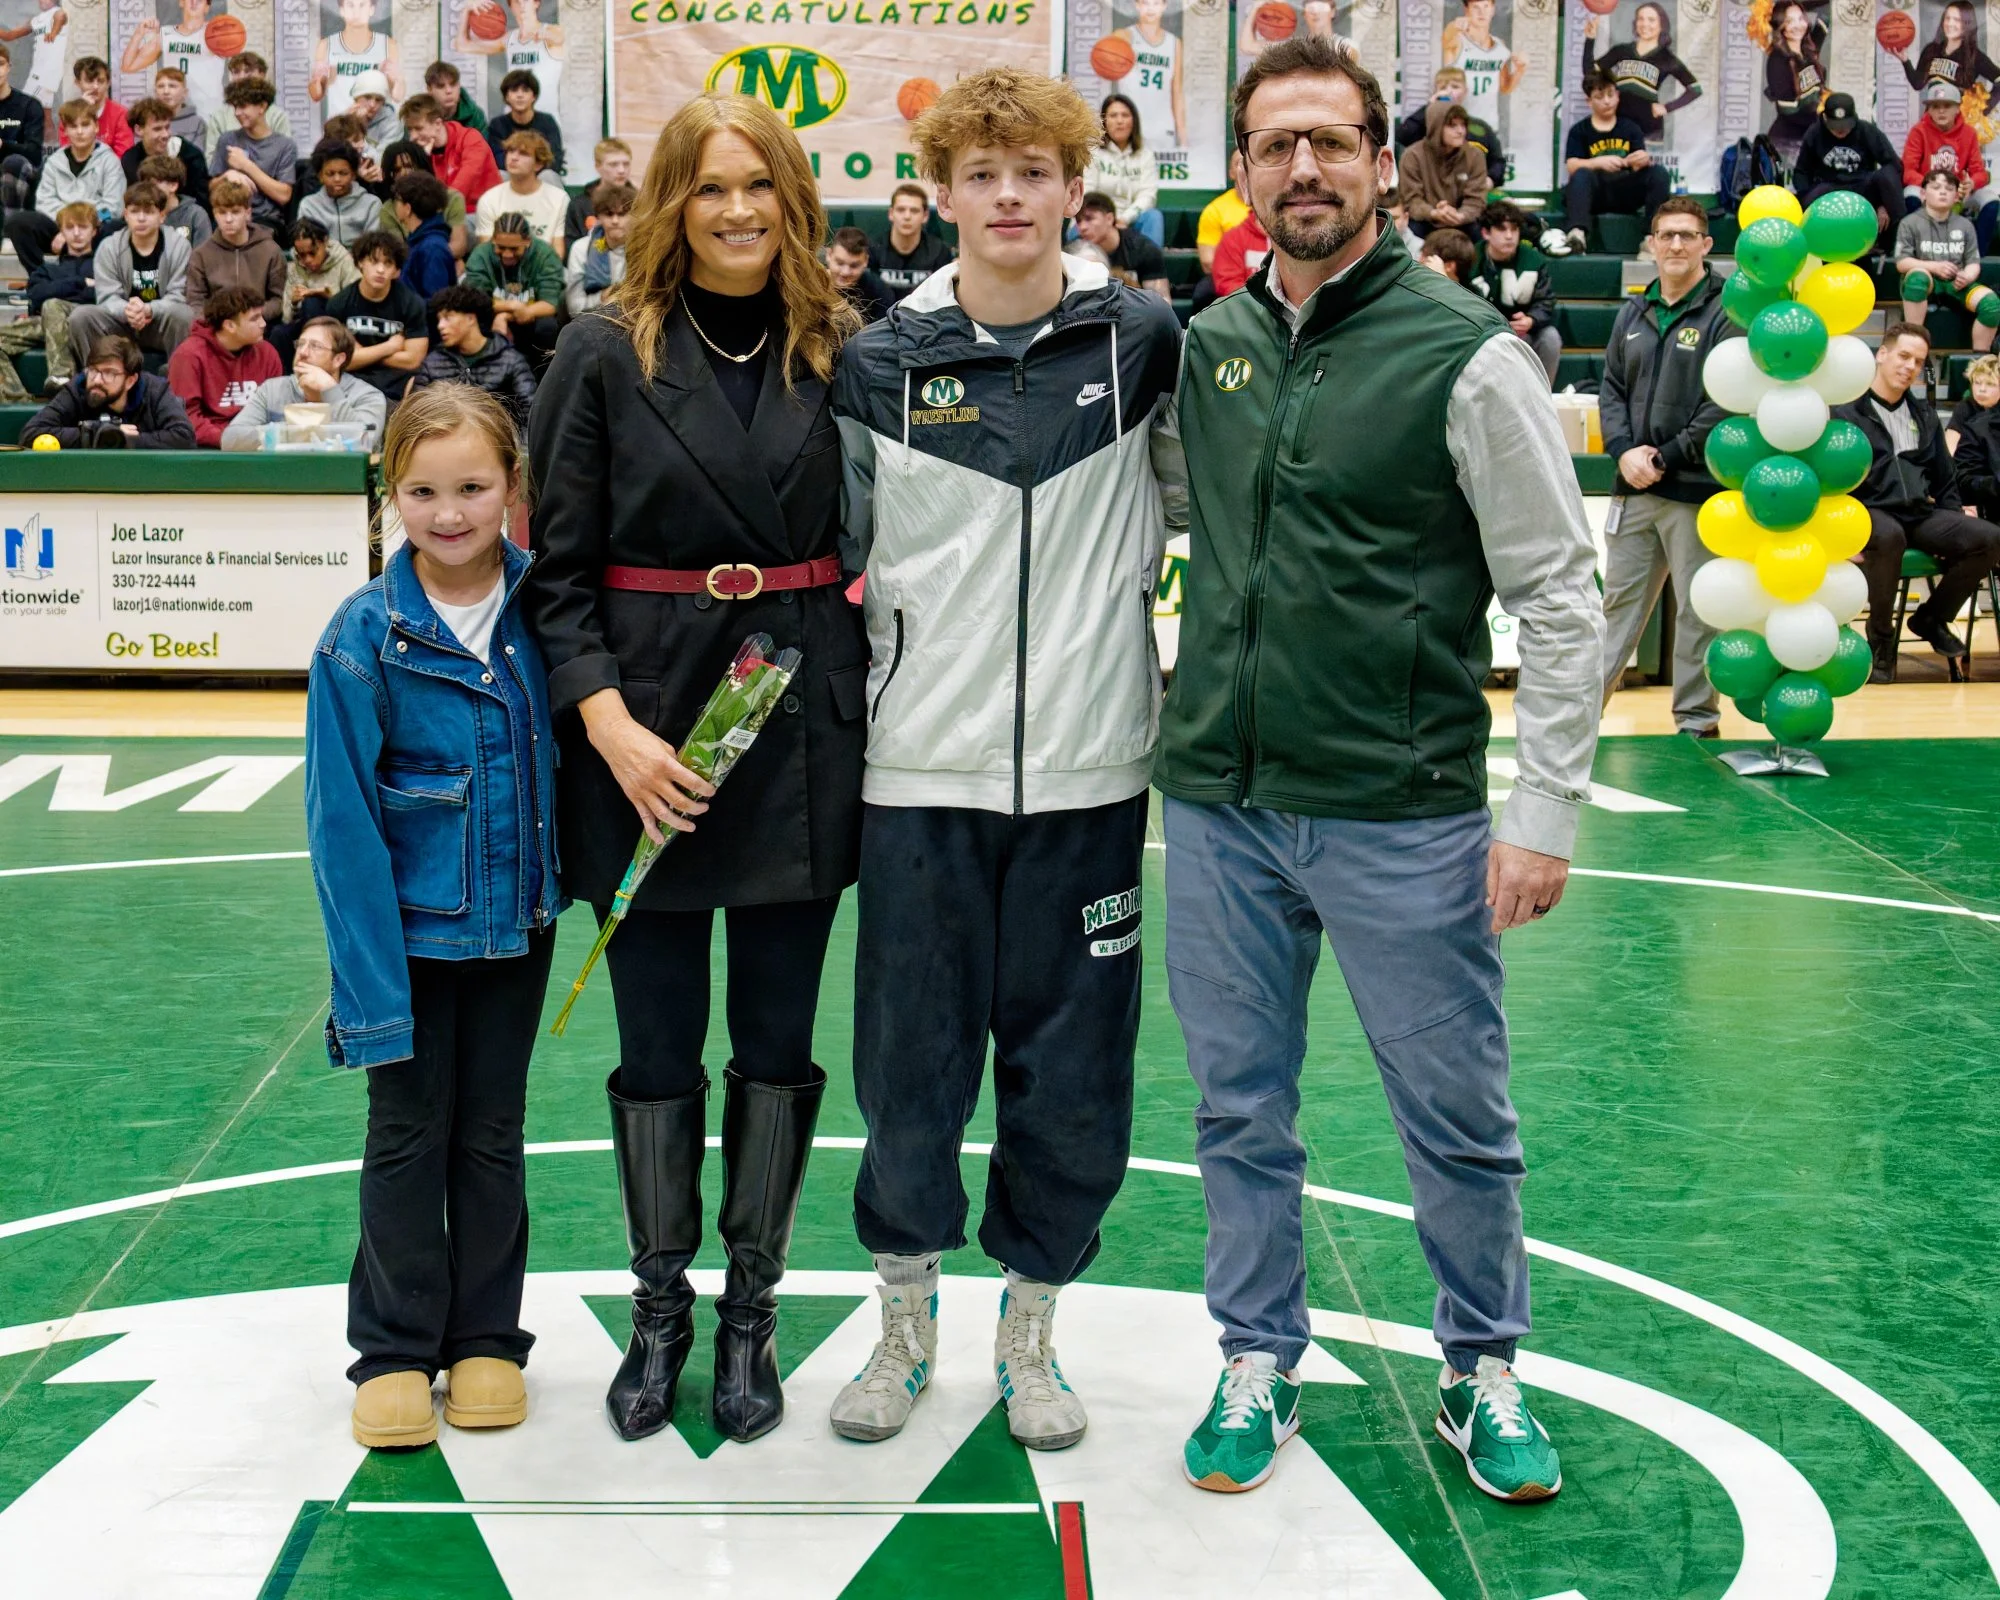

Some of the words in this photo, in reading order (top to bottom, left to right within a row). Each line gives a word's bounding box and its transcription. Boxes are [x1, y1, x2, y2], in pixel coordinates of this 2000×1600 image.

[631, 1, 1035, 25] CONGRATULATIONS
[168, 42, 201, 55] MEDINA
[1137, 52, 1169, 67] MEDINA
[730, 47, 833, 129] M
[1140, 69, 1163, 90] 34
[1501, 268, 1538, 306] M
[1218, 360, 1248, 388] M
[925, 378, 961, 405] M
[1082, 383, 1107, 396] NIKE
[910, 407, 980, 425] WRESTLING
[111, 523, 137, 541] Joe
[142, 523, 184, 541] Lazor
[112, 551, 142, 565] Lazor
[146, 551, 202, 565] Insurance
[206, 551, 216, 565] &
[218, 551, 271, 565] Financial
[275, 552, 323, 565] Services
[327, 552, 348, 565] LLC
[112, 574, 196, 588] 330-722-4444
[0, 589, 80, 604] tionwide
[113, 597, 253, 614] lazorj1@nationwide.com
[3, 607, 17, 616] on
[20, 607, 42, 617] your
[46, 606, 67, 616] side
[106, 631, 143, 657] Go
[149, 632, 219, 658] Bees!
[1082, 885, 1142, 935] MEDIN
